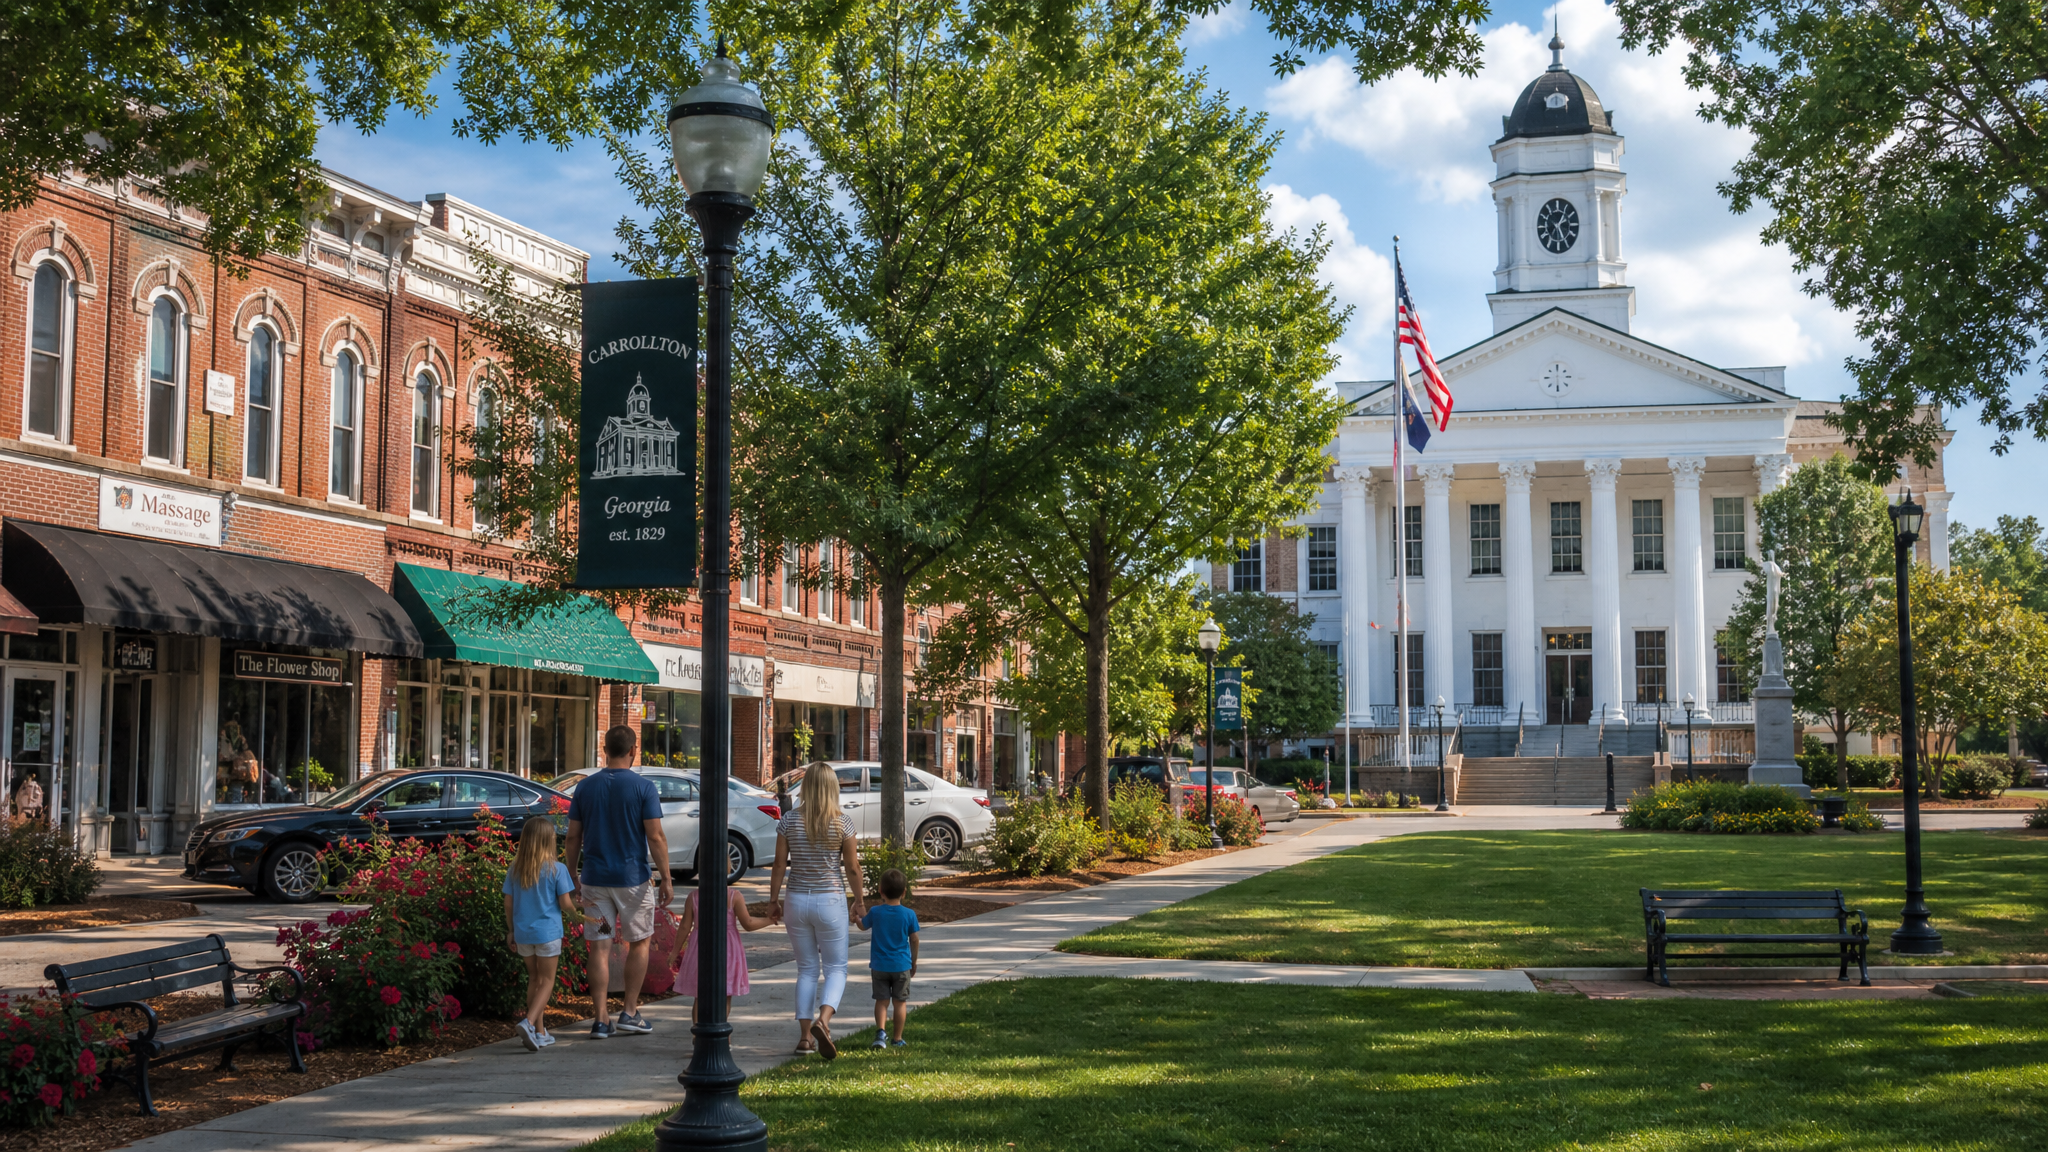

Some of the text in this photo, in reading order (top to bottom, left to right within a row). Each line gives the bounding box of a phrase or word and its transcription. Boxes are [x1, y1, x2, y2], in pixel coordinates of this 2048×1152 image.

[588, 335, 692, 364] CARROLLTON
[141, 493, 211, 527] Massage
[604, 496, 671, 519] Georgia
[609, 527, 665, 541] est. 1829
[239, 655, 339, 681] The Flower Shop
